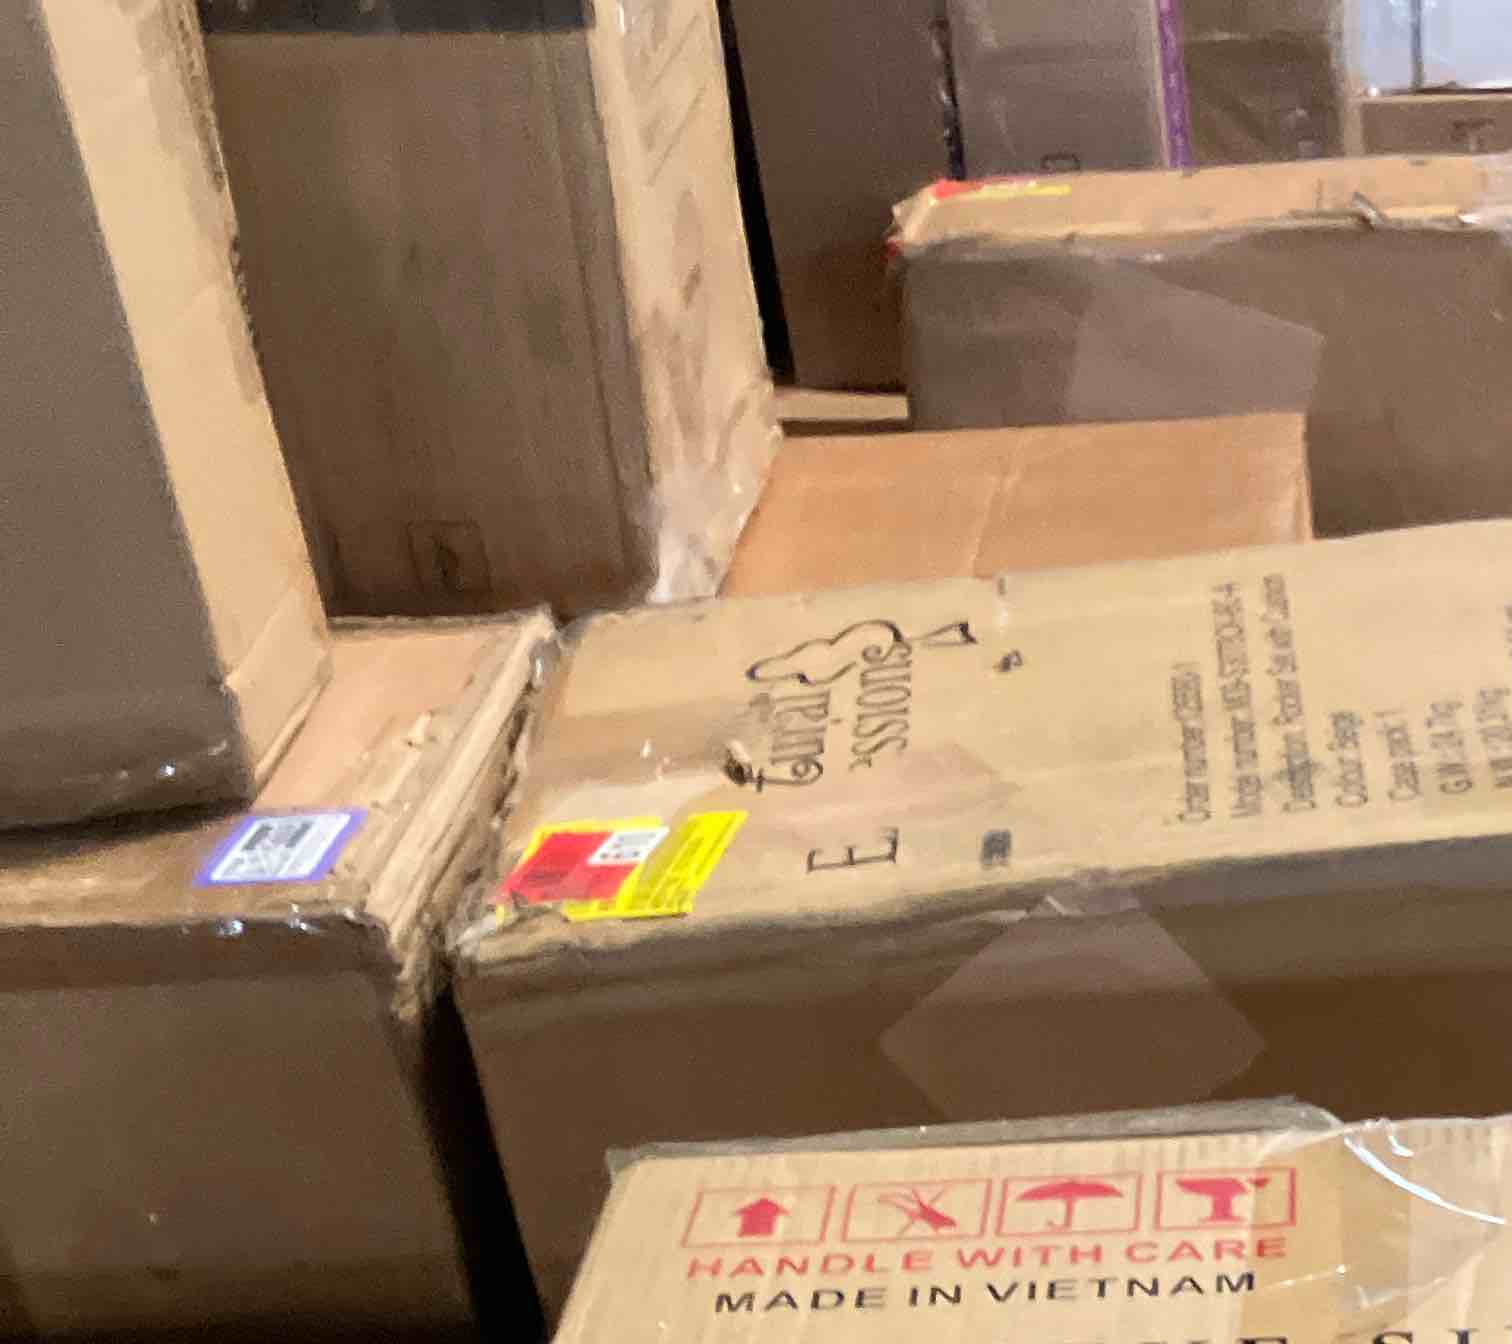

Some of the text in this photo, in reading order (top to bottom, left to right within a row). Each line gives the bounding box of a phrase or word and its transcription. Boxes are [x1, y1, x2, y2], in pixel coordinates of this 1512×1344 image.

[687, 1237, 1288, 1281] HANDLE WITH CARE
[713, 1271, 1257, 1315] MADE IN VIETNAM
